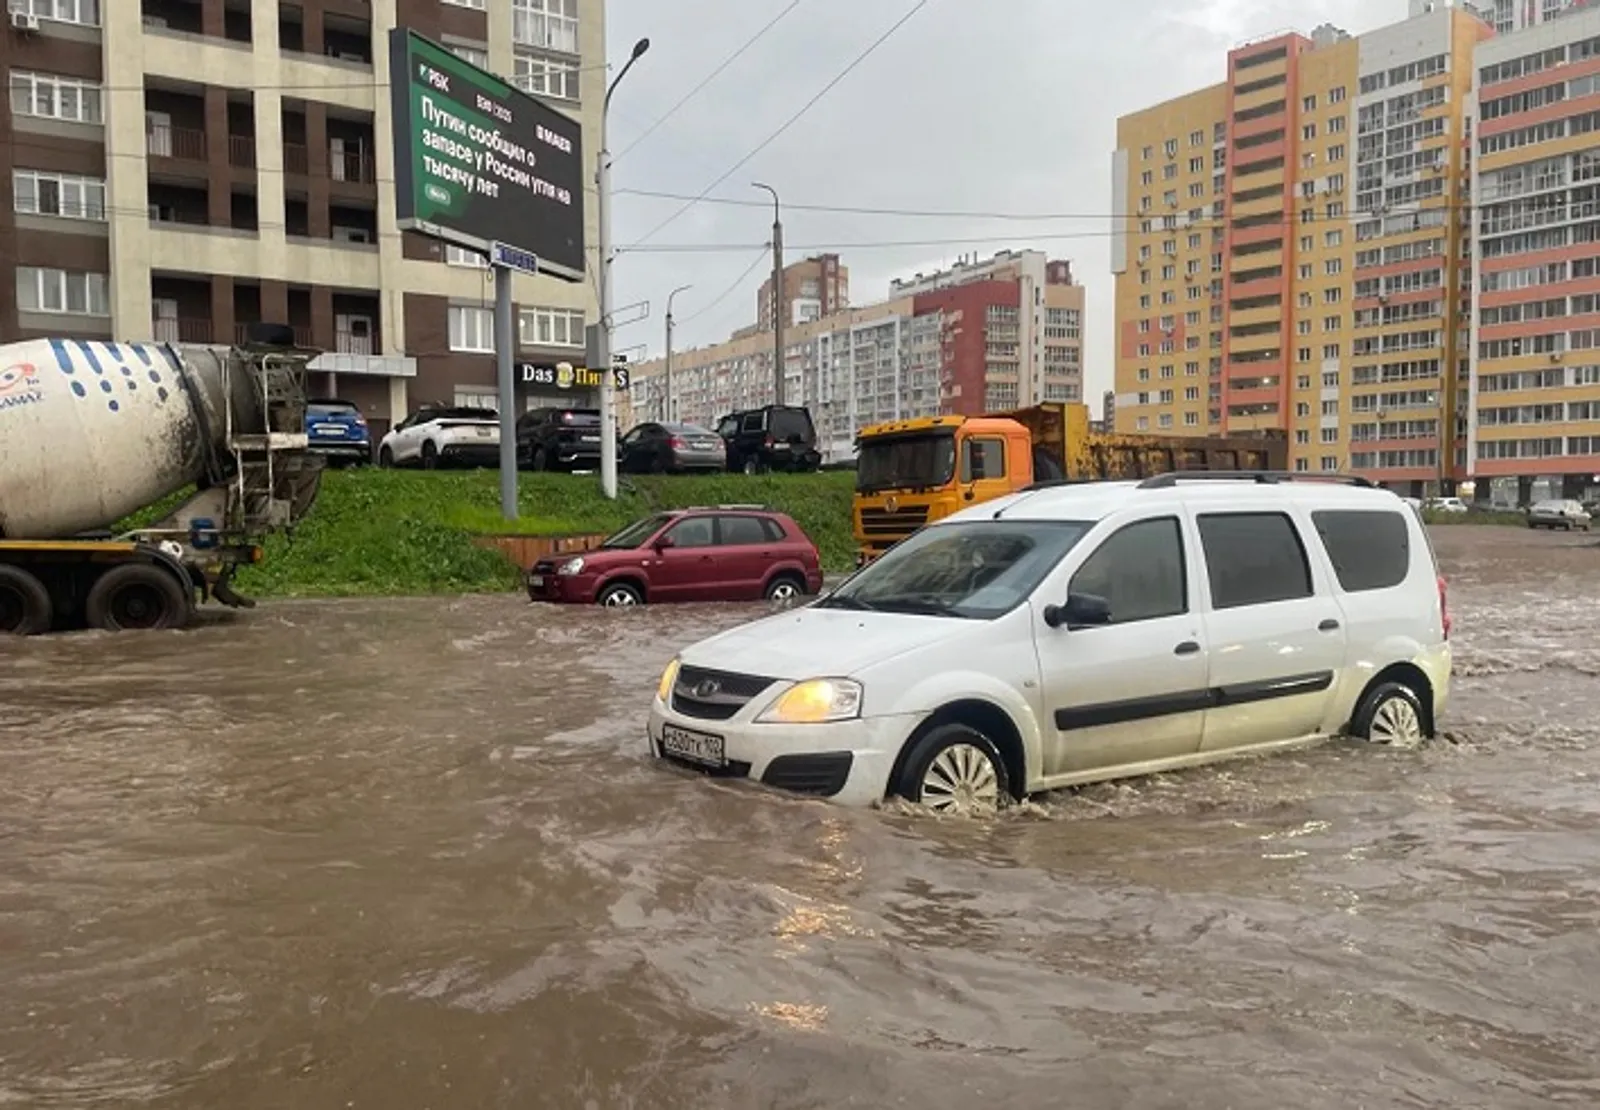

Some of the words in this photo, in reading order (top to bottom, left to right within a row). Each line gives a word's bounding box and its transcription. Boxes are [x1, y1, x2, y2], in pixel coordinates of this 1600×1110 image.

[428, 67, 450, 92] РБК
[421, 95, 467, 136] Путин
[467, 124, 526, 163] сообщил
[527, 151, 535, 167] о
[422, 129, 473, 164] запасе
[474, 151, 483, 171] у
[485, 151, 530, 188] России
[531, 176, 555, 198] угля
[556, 187, 571, 205] на
[422, 154, 475, 193] тысячу
[477, 177, 499, 198] лет
[522, 363, 553, 383] Das
